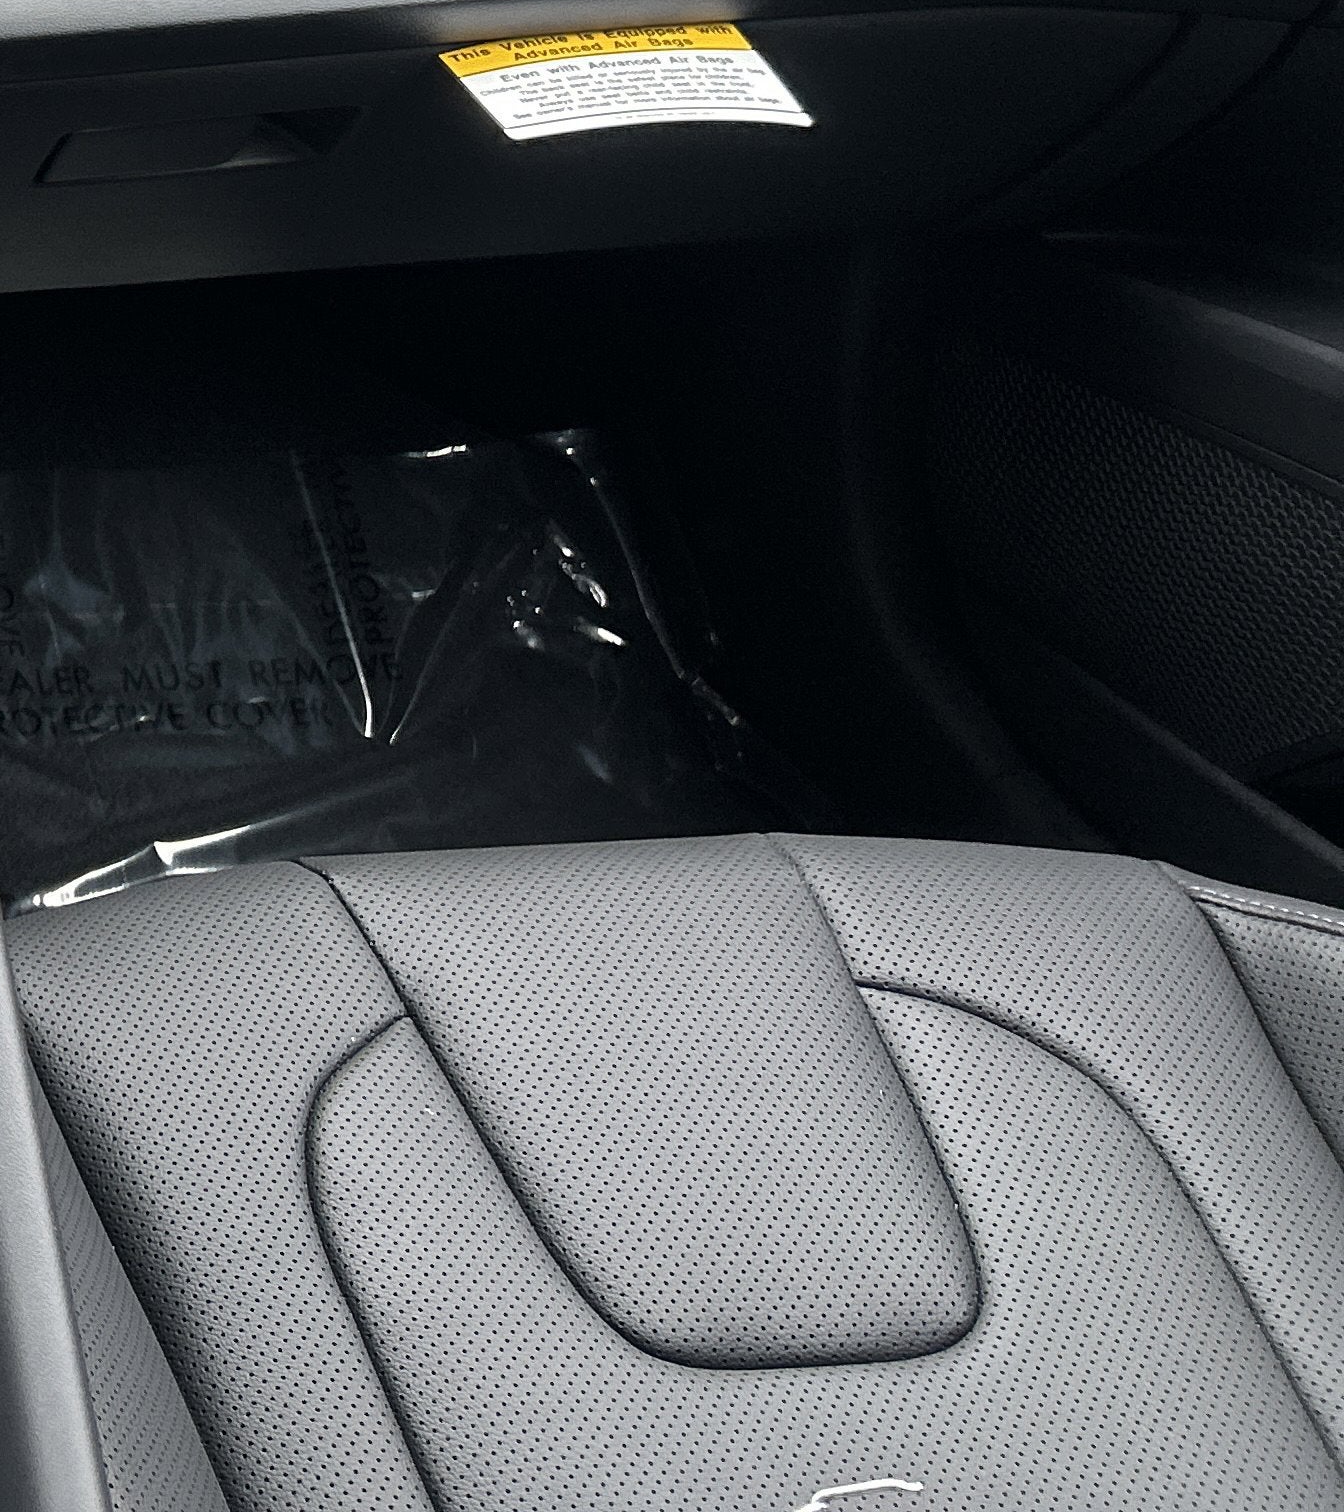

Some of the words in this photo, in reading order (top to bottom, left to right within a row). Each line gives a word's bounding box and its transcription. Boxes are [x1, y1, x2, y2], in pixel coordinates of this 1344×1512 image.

[448, 49, 490, 63] This
[499, 35, 568, 51] Vehicle
[605, 26, 687, 39] Equipped
[696, 25, 734, 35] with
[514, 42, 603, 61] Advanced
[614, 39, 638, 49] Air
[647, 37, 694, 48] Bags
[500, 70, 540, 83] Even
[547, 64, 580, 74] with
[589, 56, 662, 69] Advanced
[669, 56, 689, 65] Air
[696, 55, 734, 66] Bags
[121, 660, 224, 692] MUST
